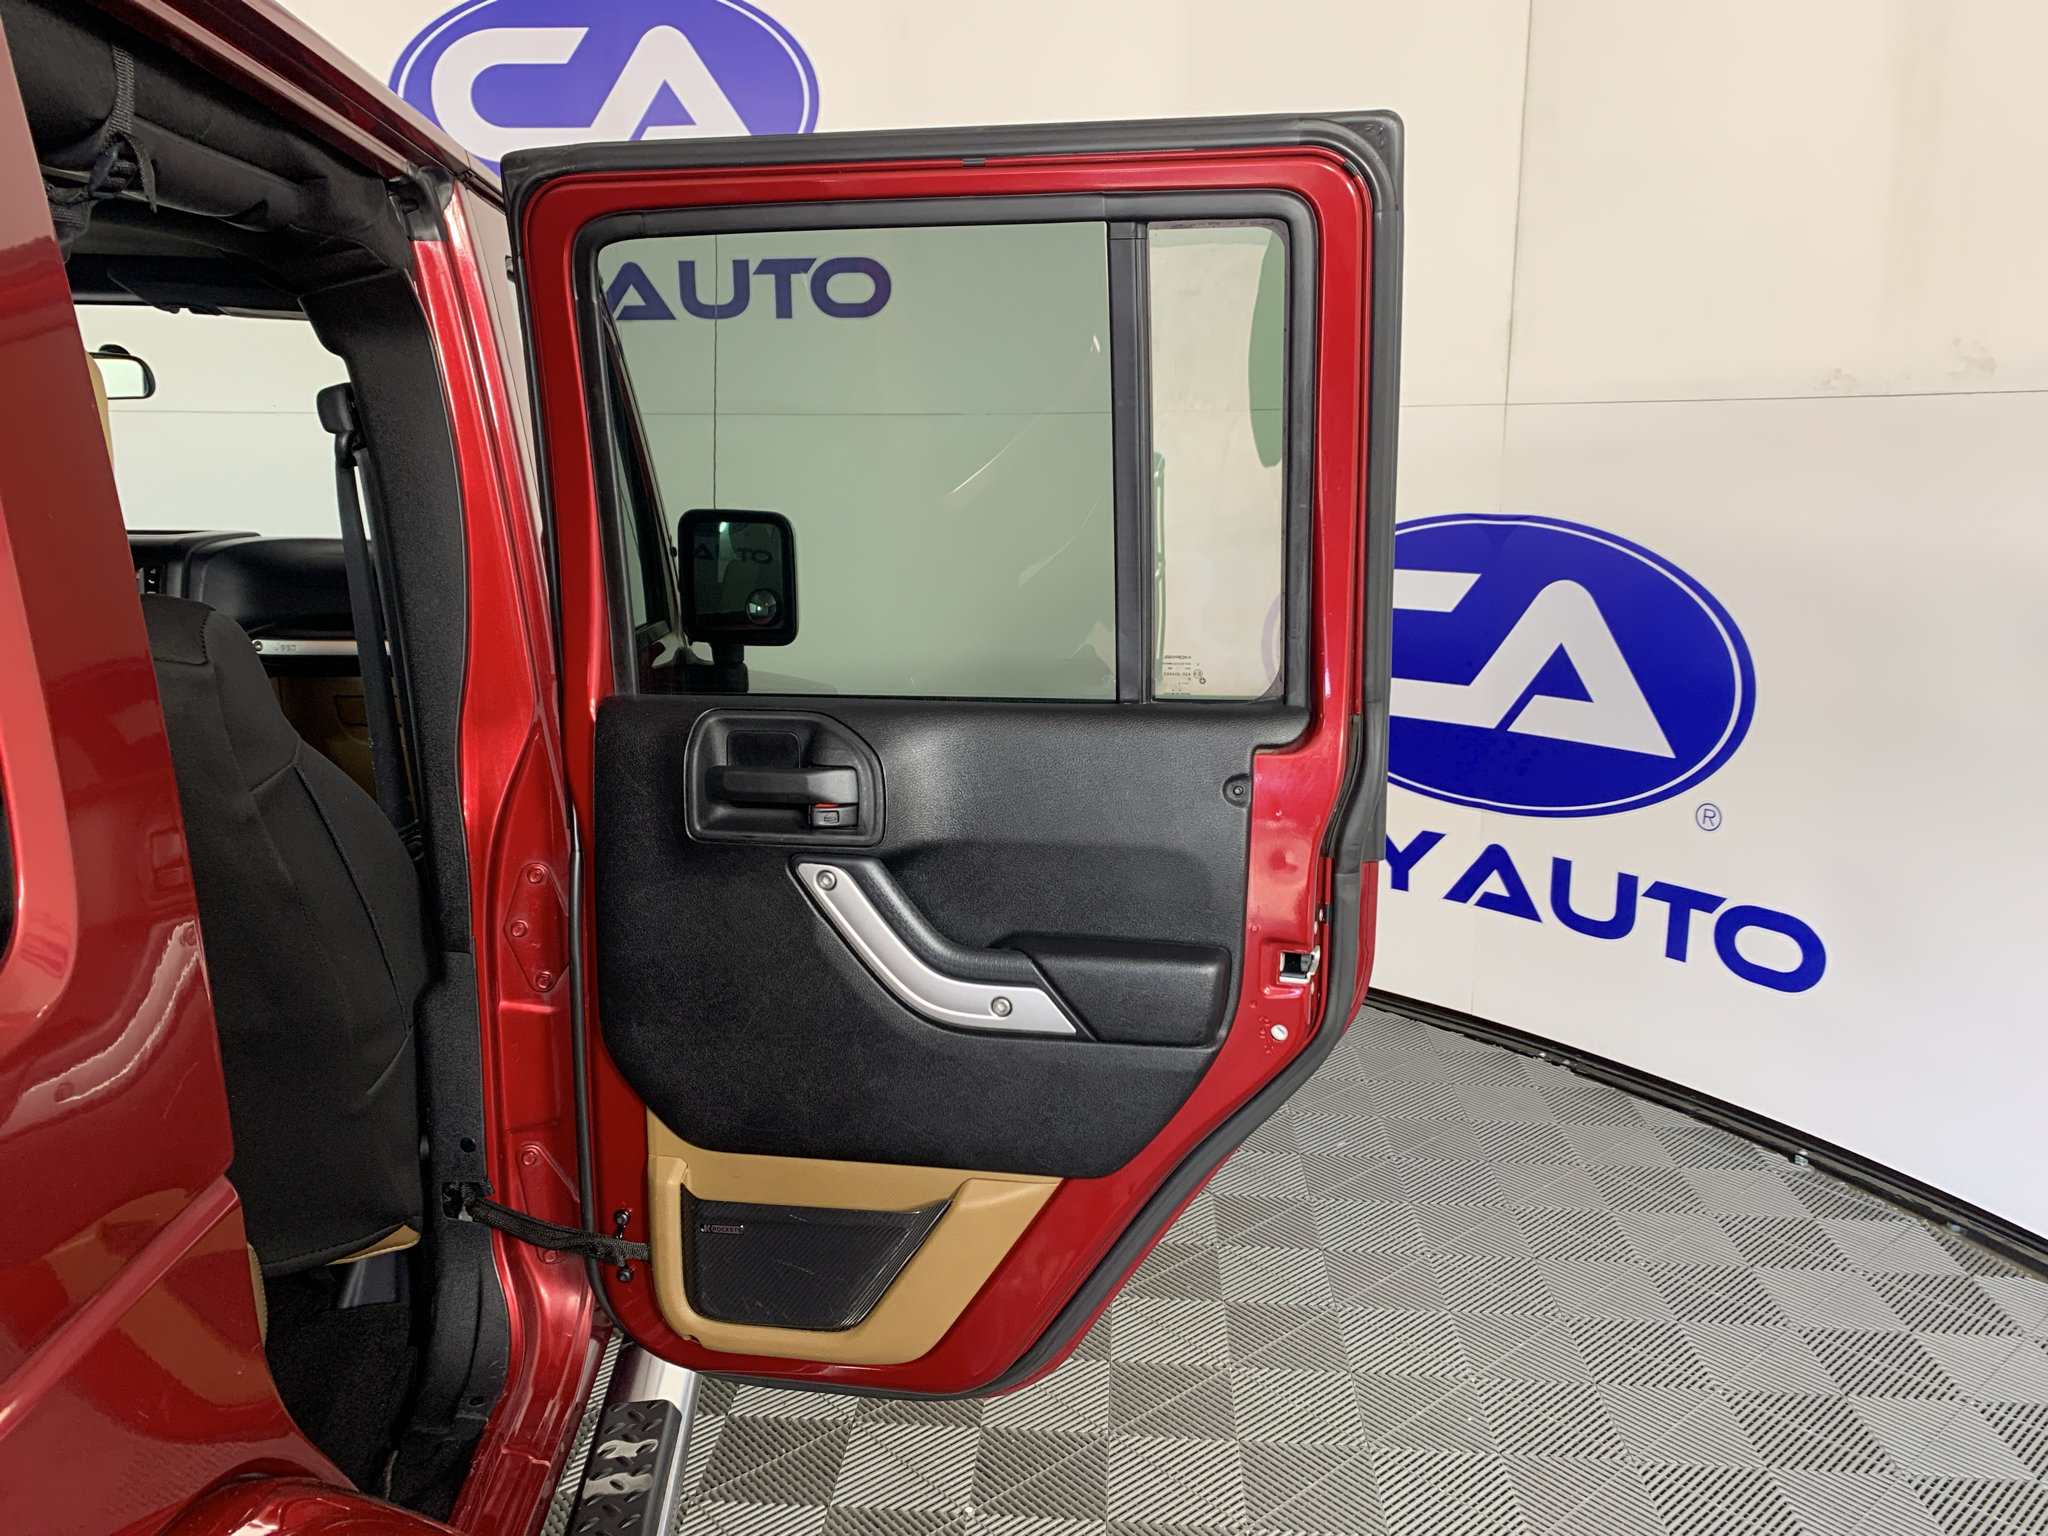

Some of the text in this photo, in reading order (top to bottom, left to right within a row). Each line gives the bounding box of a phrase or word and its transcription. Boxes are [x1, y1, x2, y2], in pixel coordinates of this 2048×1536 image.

[431, 25, 749, 161] CA
[605, 256, 892, 321] AUTO
[1444, 843, 1827, 993] AUTO
[712, 1226, 743, 1234] POCKETS
